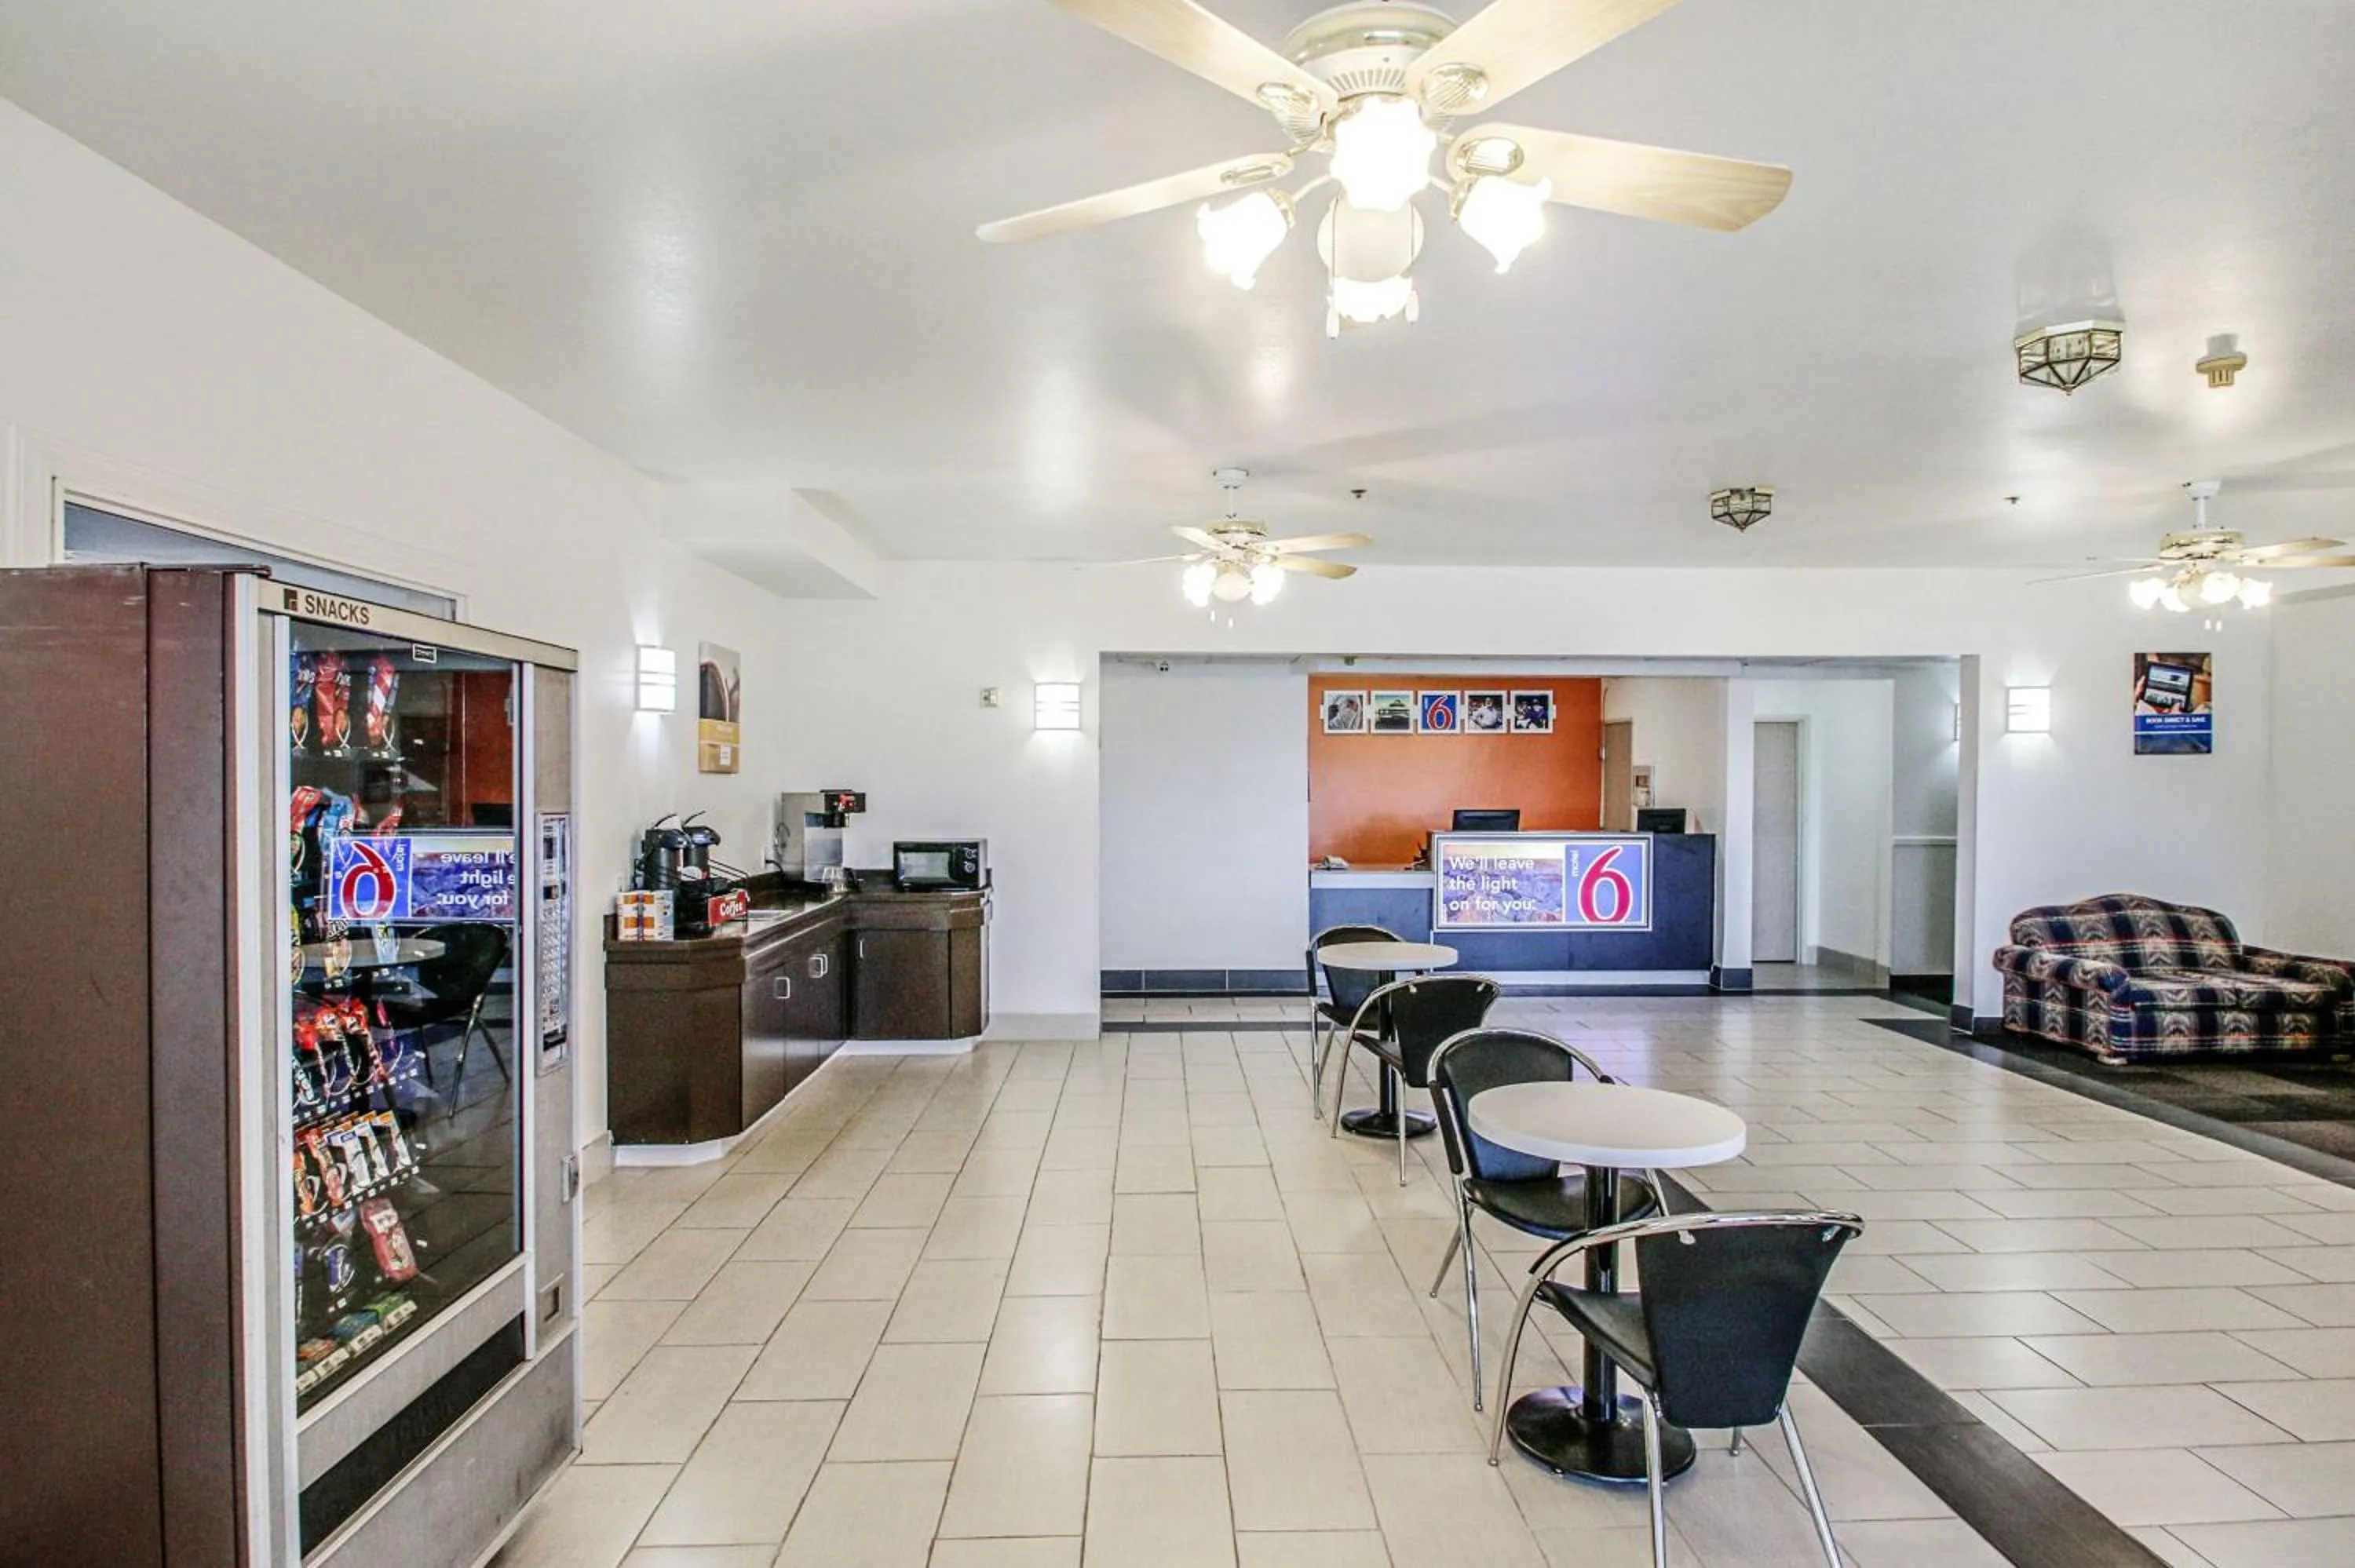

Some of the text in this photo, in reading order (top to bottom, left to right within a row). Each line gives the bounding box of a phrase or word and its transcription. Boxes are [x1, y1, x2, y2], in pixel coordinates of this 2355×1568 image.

[305, 594, 370, 625] SNACKS
[1427, 695, 1453, 730] 6
[1449, 855, 1535, 870] We'll leave
[1449, 875, 1518, 895] the light
[1578, 845, 1634, 924] 6
[1449, 900, 1470, 911] on
[1476, 895, 1498, 910] for
